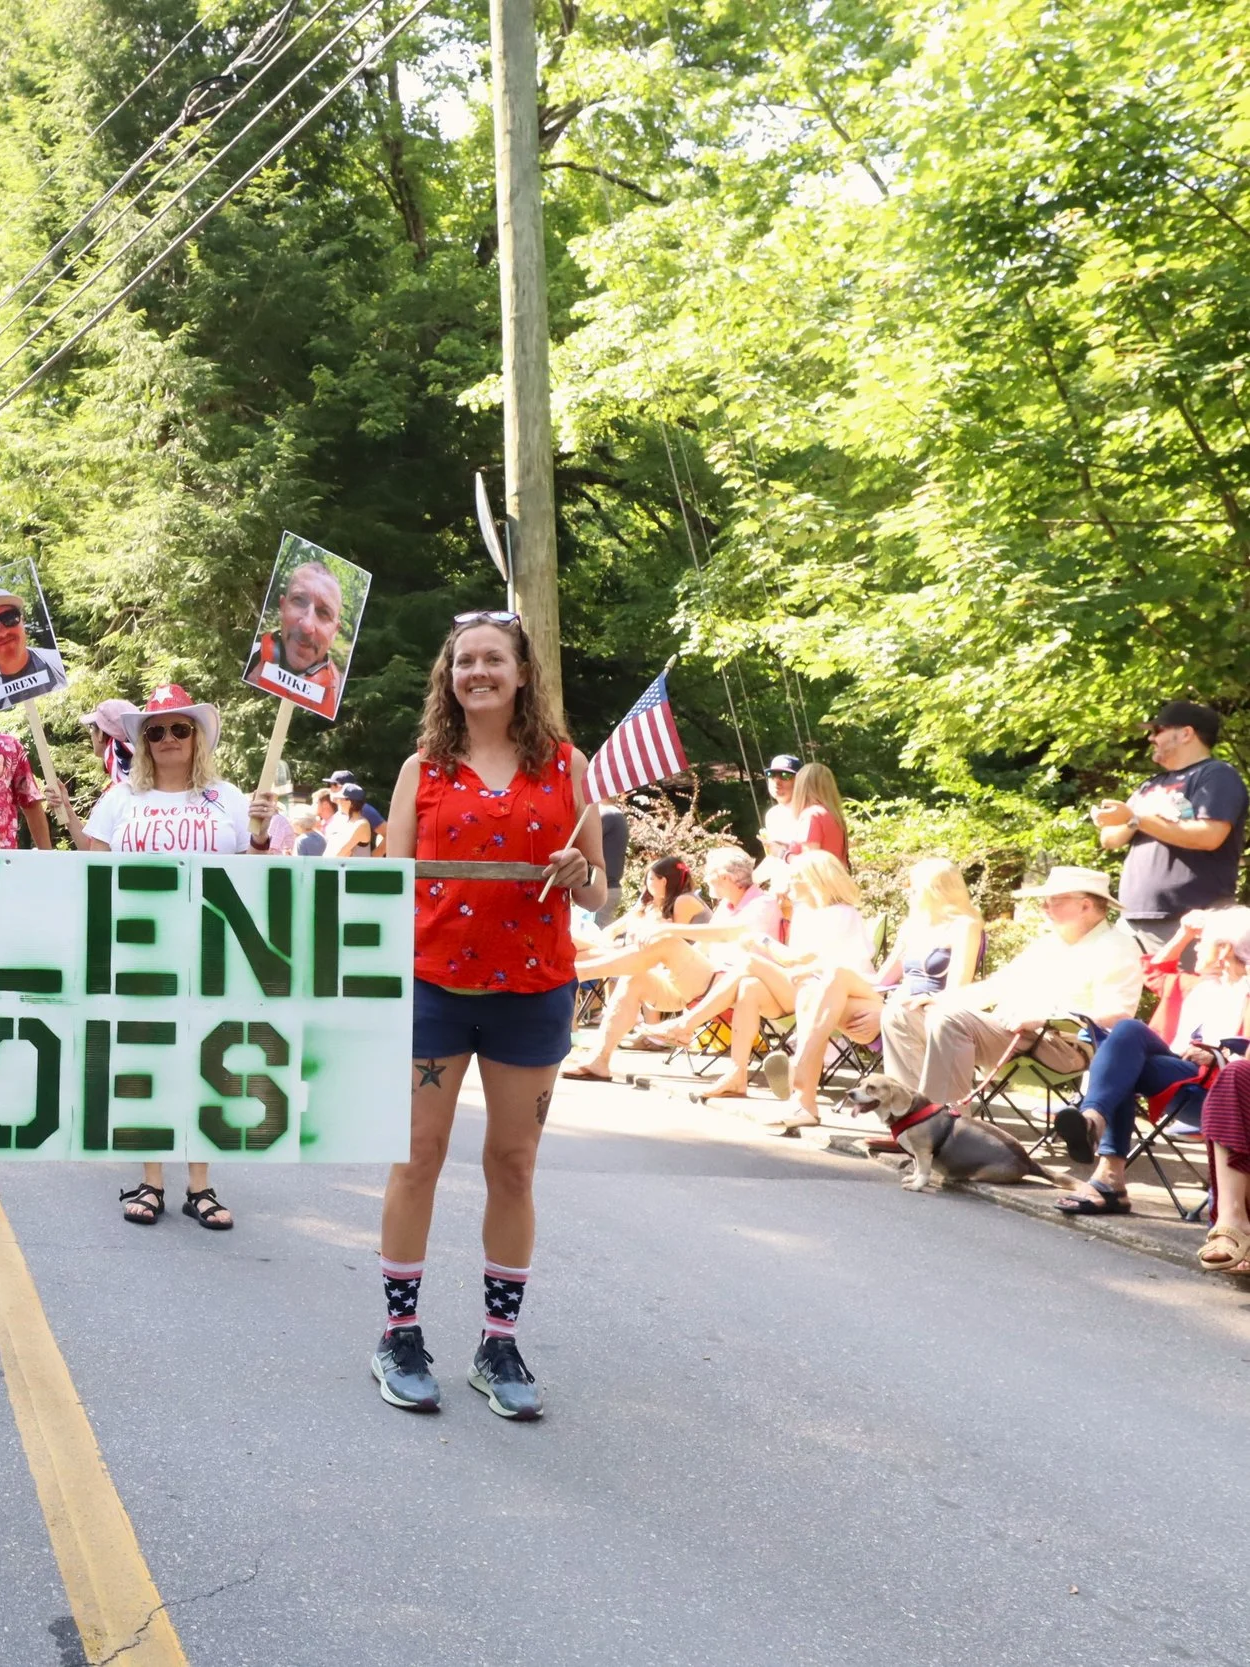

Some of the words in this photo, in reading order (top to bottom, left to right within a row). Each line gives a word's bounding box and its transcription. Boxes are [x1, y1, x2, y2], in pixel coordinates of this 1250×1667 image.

[4, 676, 38, 694] DREW
[277, 670, 312, 695] MIKE
[133, 806, 137, 818] I
[185, 805, 211, 819] my
[121, 819, 219, 852] AWESOME
